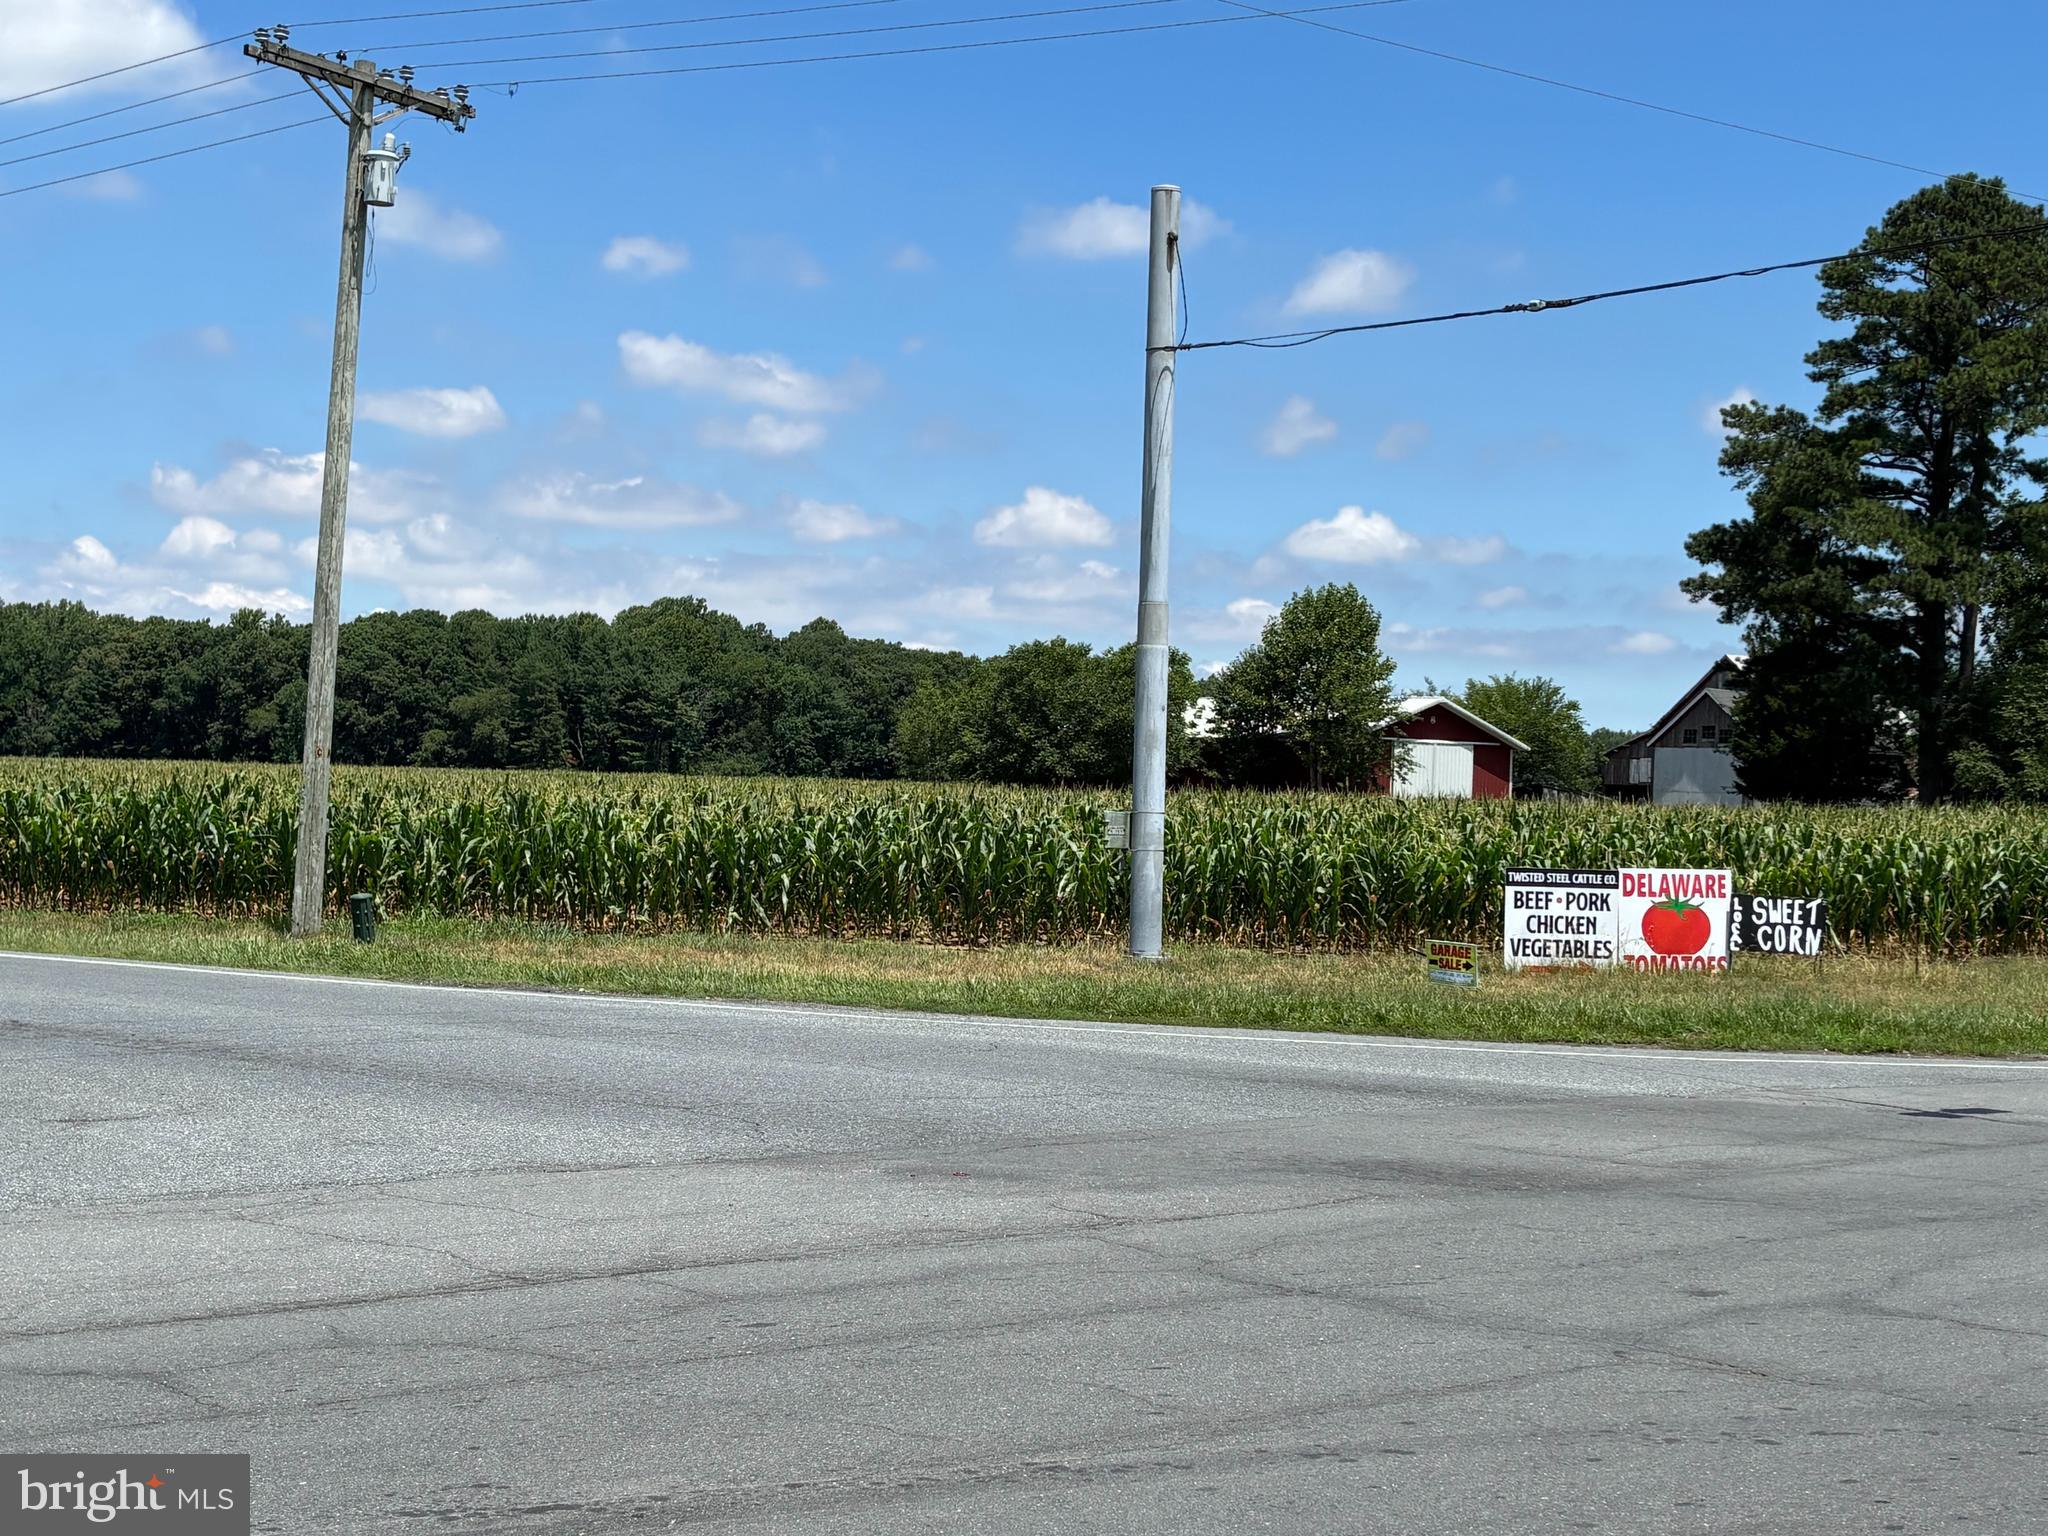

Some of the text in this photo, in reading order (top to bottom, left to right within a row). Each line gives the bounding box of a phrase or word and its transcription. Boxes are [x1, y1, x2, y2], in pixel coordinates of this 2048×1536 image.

[1508, 872, 1544, 882] TWISTED
[1546, 873, 1570, 883] STEEL
[1572, 875, 1602, 885] CATTLE
[1622, 873, 1727, 899] DELAWARE
[1513, 890, 1611, 912] BEEF PORK
[1751, 897, 1823, 925] SWEET
[1526, 915, 1597, 935] CHICKEN
[1730, 897, 1743, 951] LOCAL
[1431, 943, 1472, 960] GARAGE
[1510, 938, 1613, 960] VEGETABLES
[1757, 925, 1823, 956] CORN
[1439, 957, 1462, 971] SALE
